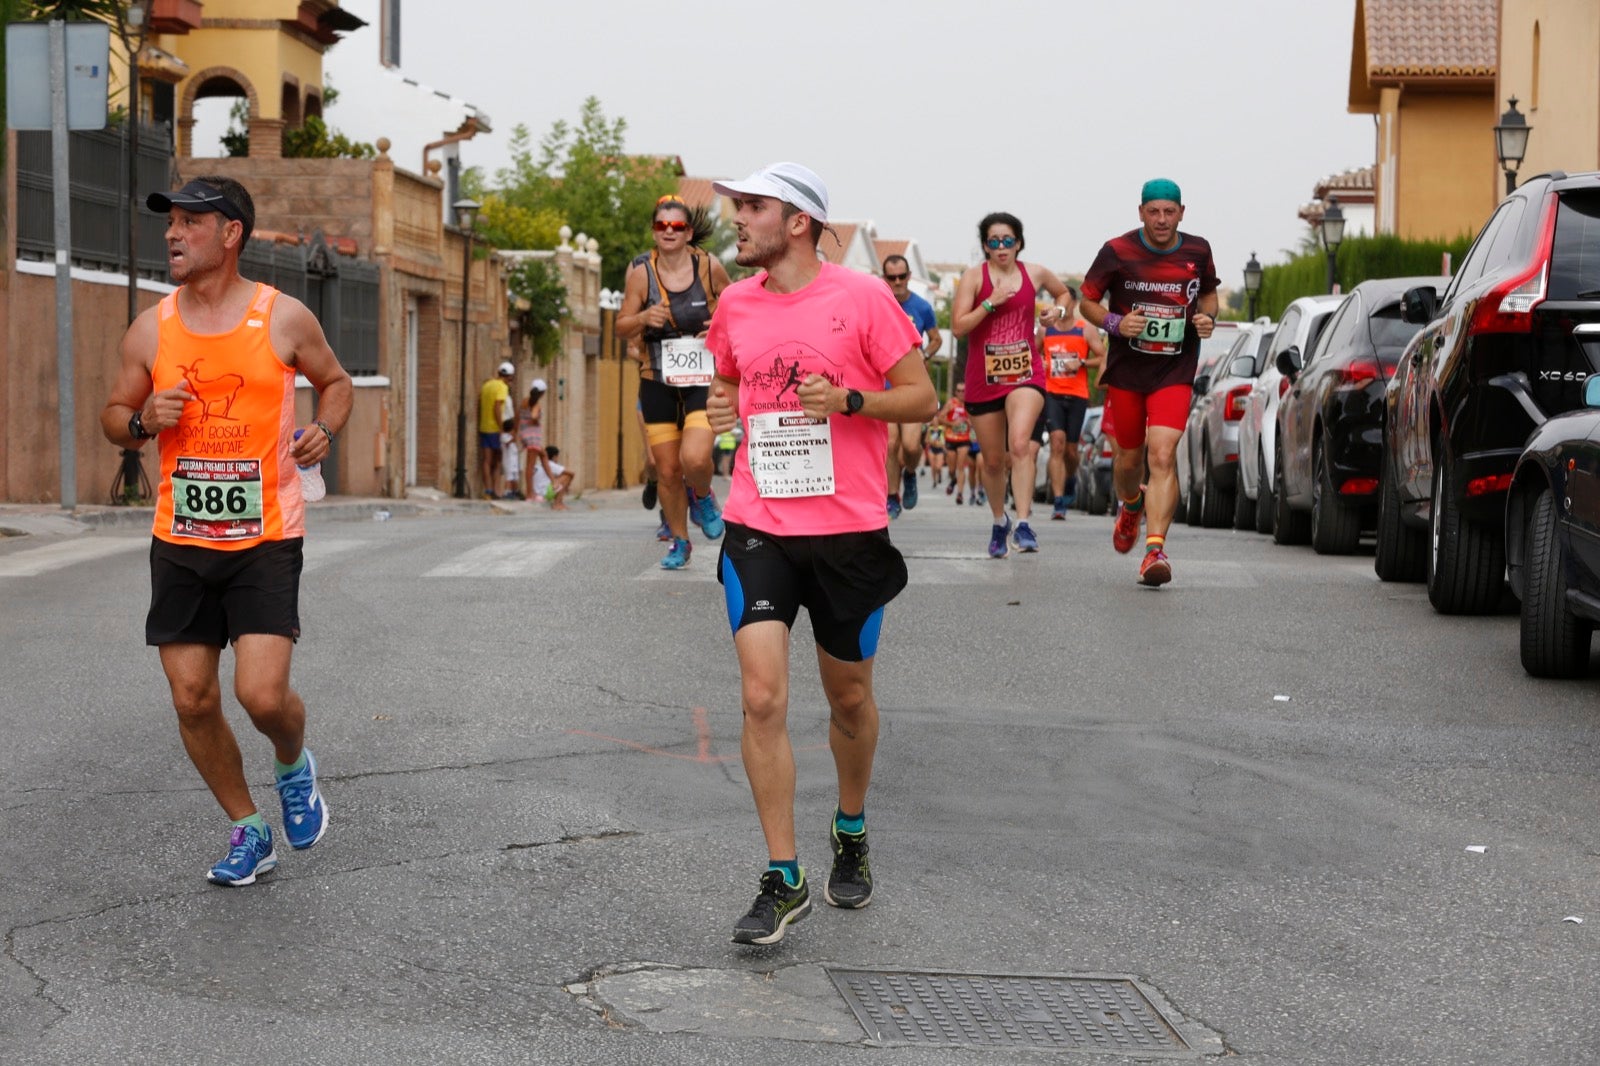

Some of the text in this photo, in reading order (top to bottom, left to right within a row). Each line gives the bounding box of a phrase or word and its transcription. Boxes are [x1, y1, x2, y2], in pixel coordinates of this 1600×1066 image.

[1124, 281, 1182, 293] GINRUNNERS
[1147, 320, 1170, 338] 61
[667, 351, 702, 370] 3081
[992, 355, 1030, 371] 2055
[209, 424, 251, 439] BOSQUE
[758, 440, 787, 448] CORRO
[790, 438, 828, 447] CONTRA
[775, 449, 810, 457] CANCER
[204, 461, 226, 472] PREMIO
[227, 463, 234, 472] DE
[804, 459, 814, 470] 2
[185, 484, 247, 514] 886
